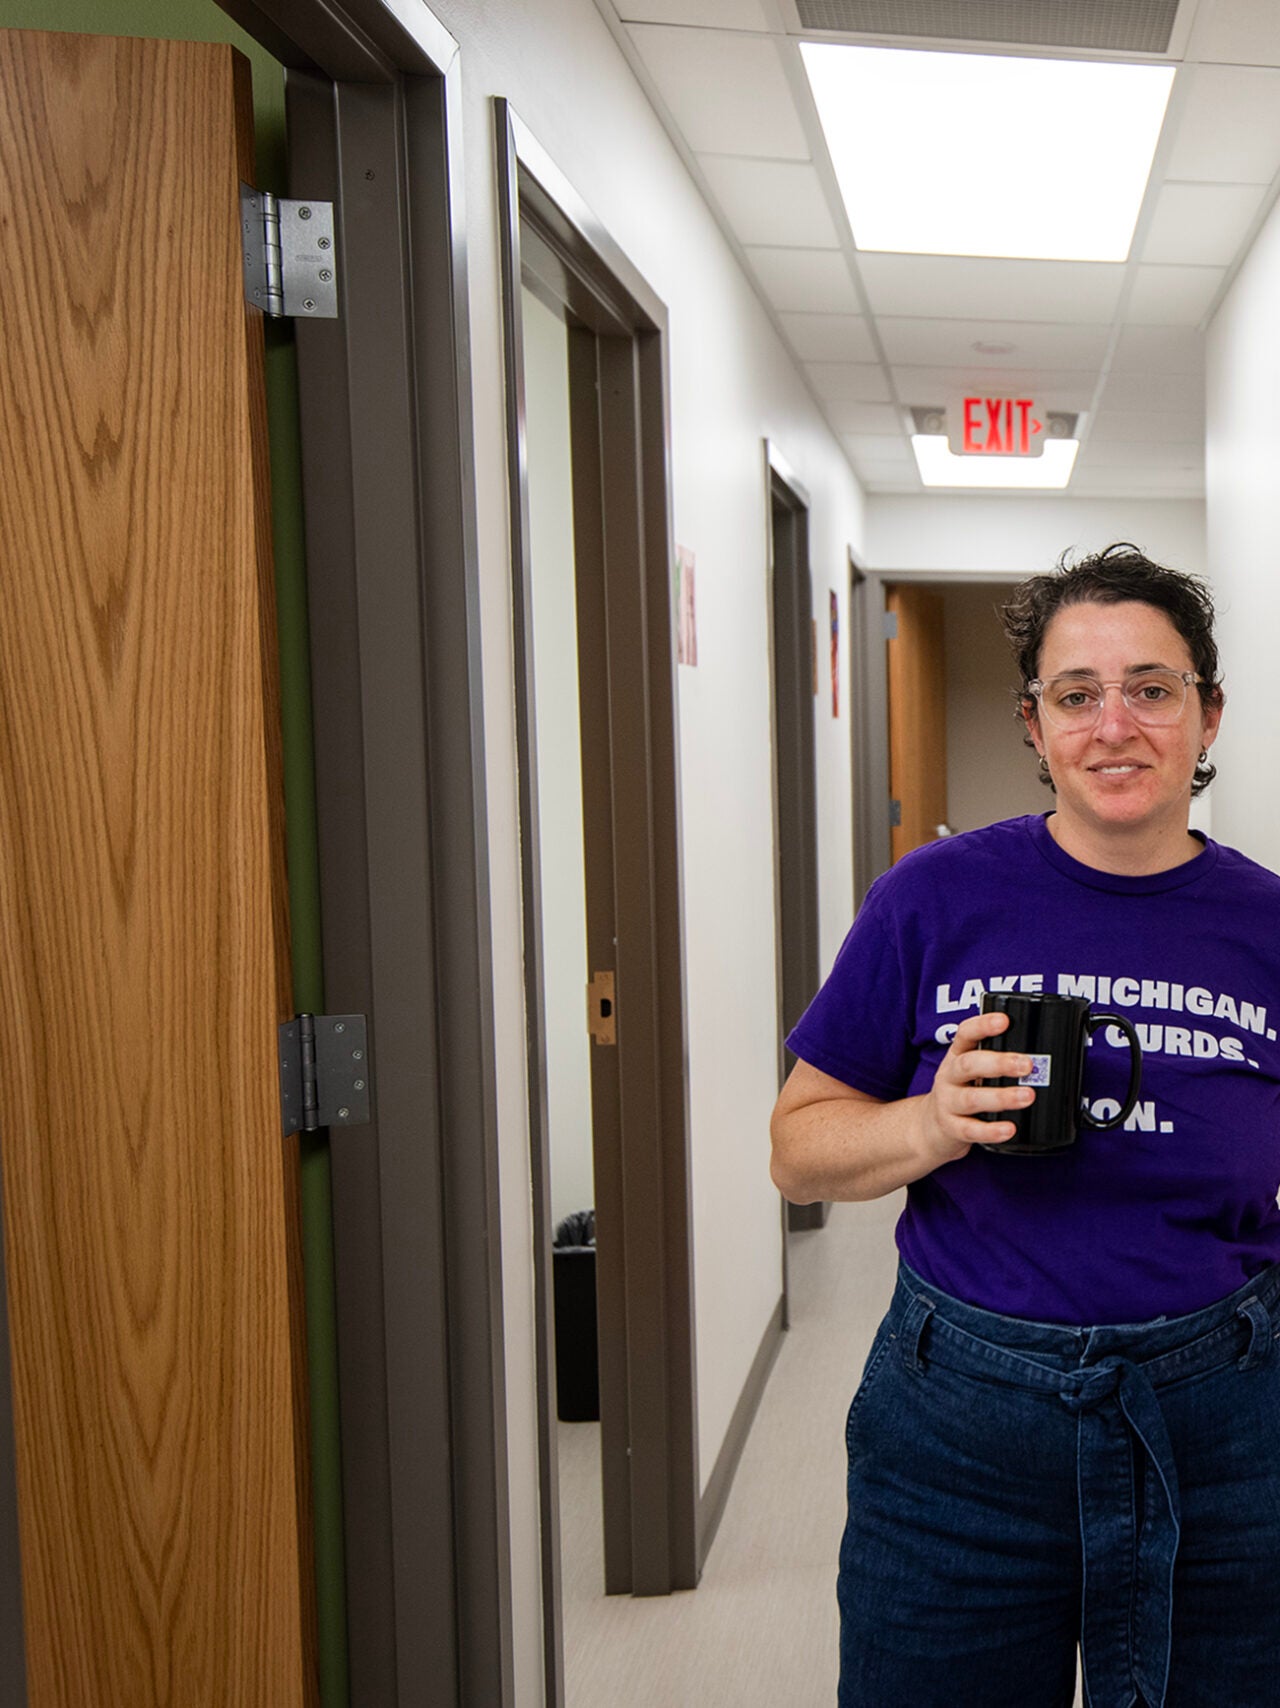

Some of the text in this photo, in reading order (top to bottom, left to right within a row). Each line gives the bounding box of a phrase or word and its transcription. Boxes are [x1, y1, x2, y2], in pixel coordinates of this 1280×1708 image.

[963, 397, 1034, 454] EXIT
[1057, 973, 1277, 1042] MICHIGAN.
[1105, 1022, 1260, 1069] CURDS.
